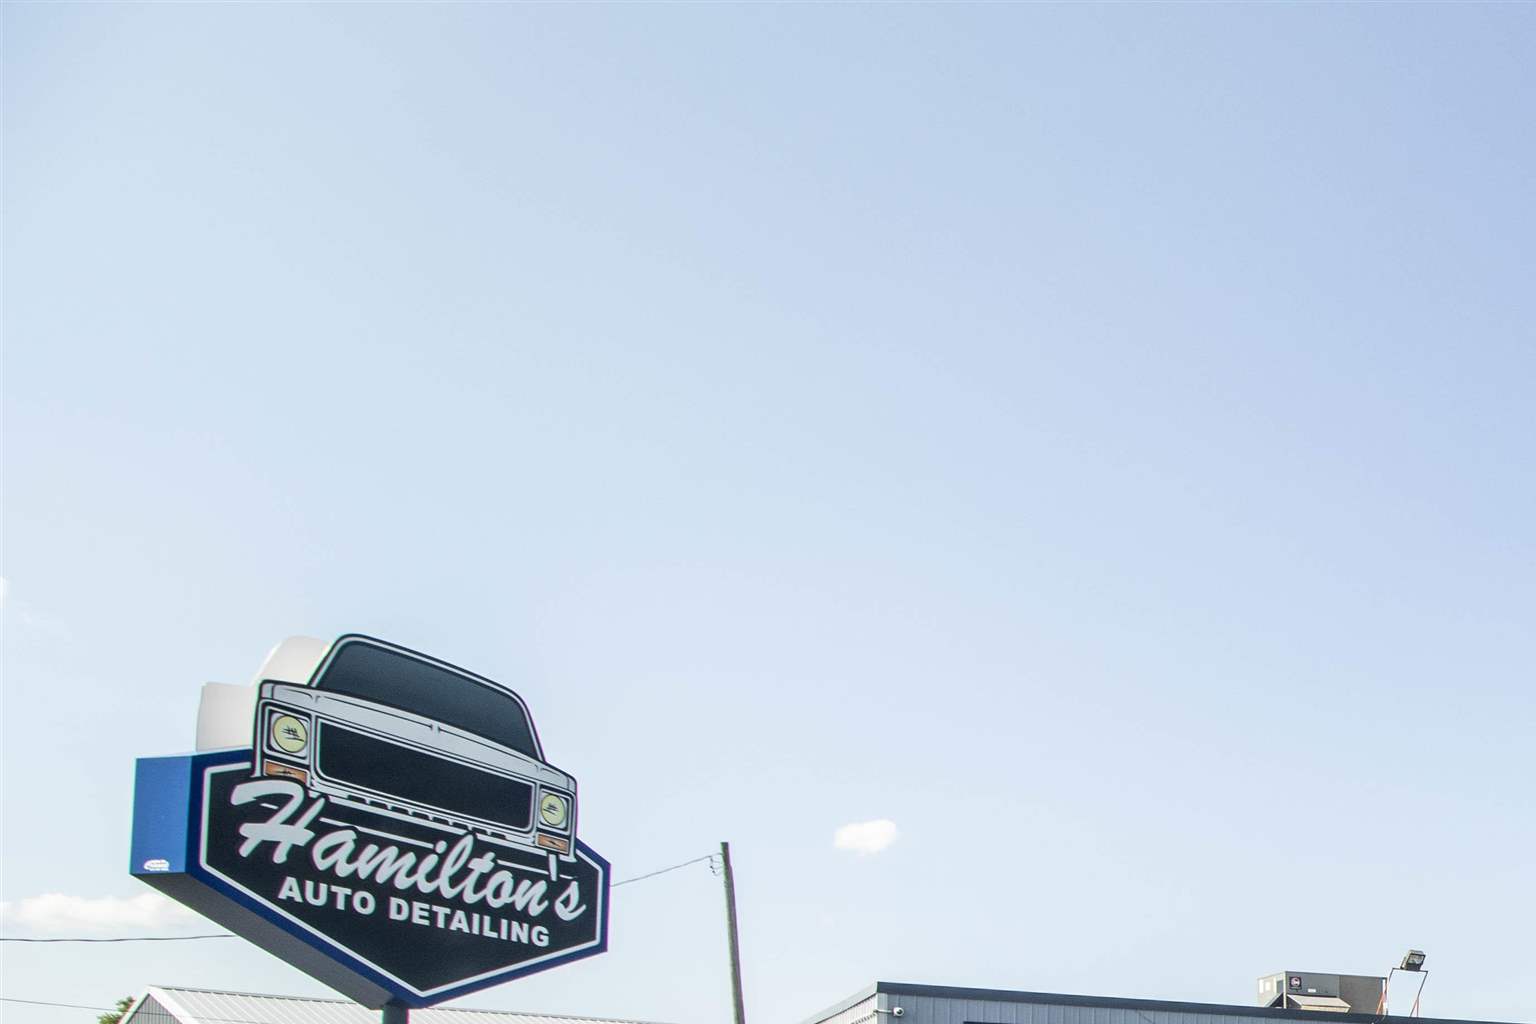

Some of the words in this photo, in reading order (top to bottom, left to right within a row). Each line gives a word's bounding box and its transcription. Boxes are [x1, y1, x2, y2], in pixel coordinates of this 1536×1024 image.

[230, 780, 587, 921] Hamilton's
[278, 876, 376, 916] AUTO
[389, 896, 550, 947] DETAILING
